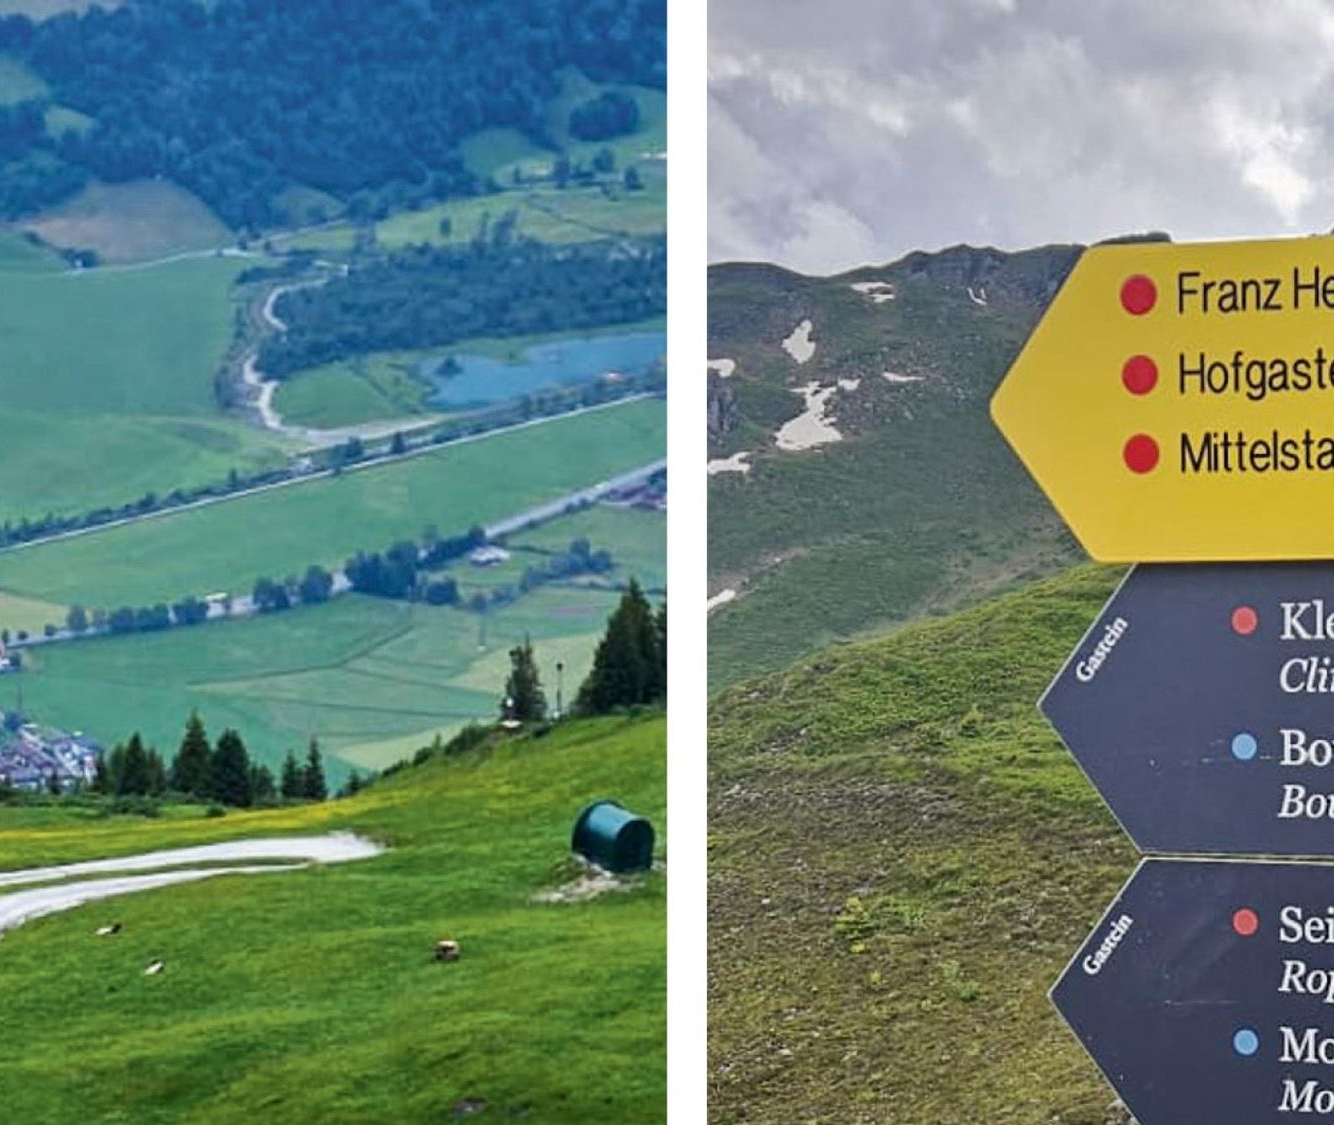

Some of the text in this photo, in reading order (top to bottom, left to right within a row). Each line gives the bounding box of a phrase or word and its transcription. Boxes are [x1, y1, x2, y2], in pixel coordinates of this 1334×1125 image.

[1178, 271, 1283, 315] Franz
[1075, 614, 1129, 683] Gastein
[1082, 913, 1135, 977] Gastein
